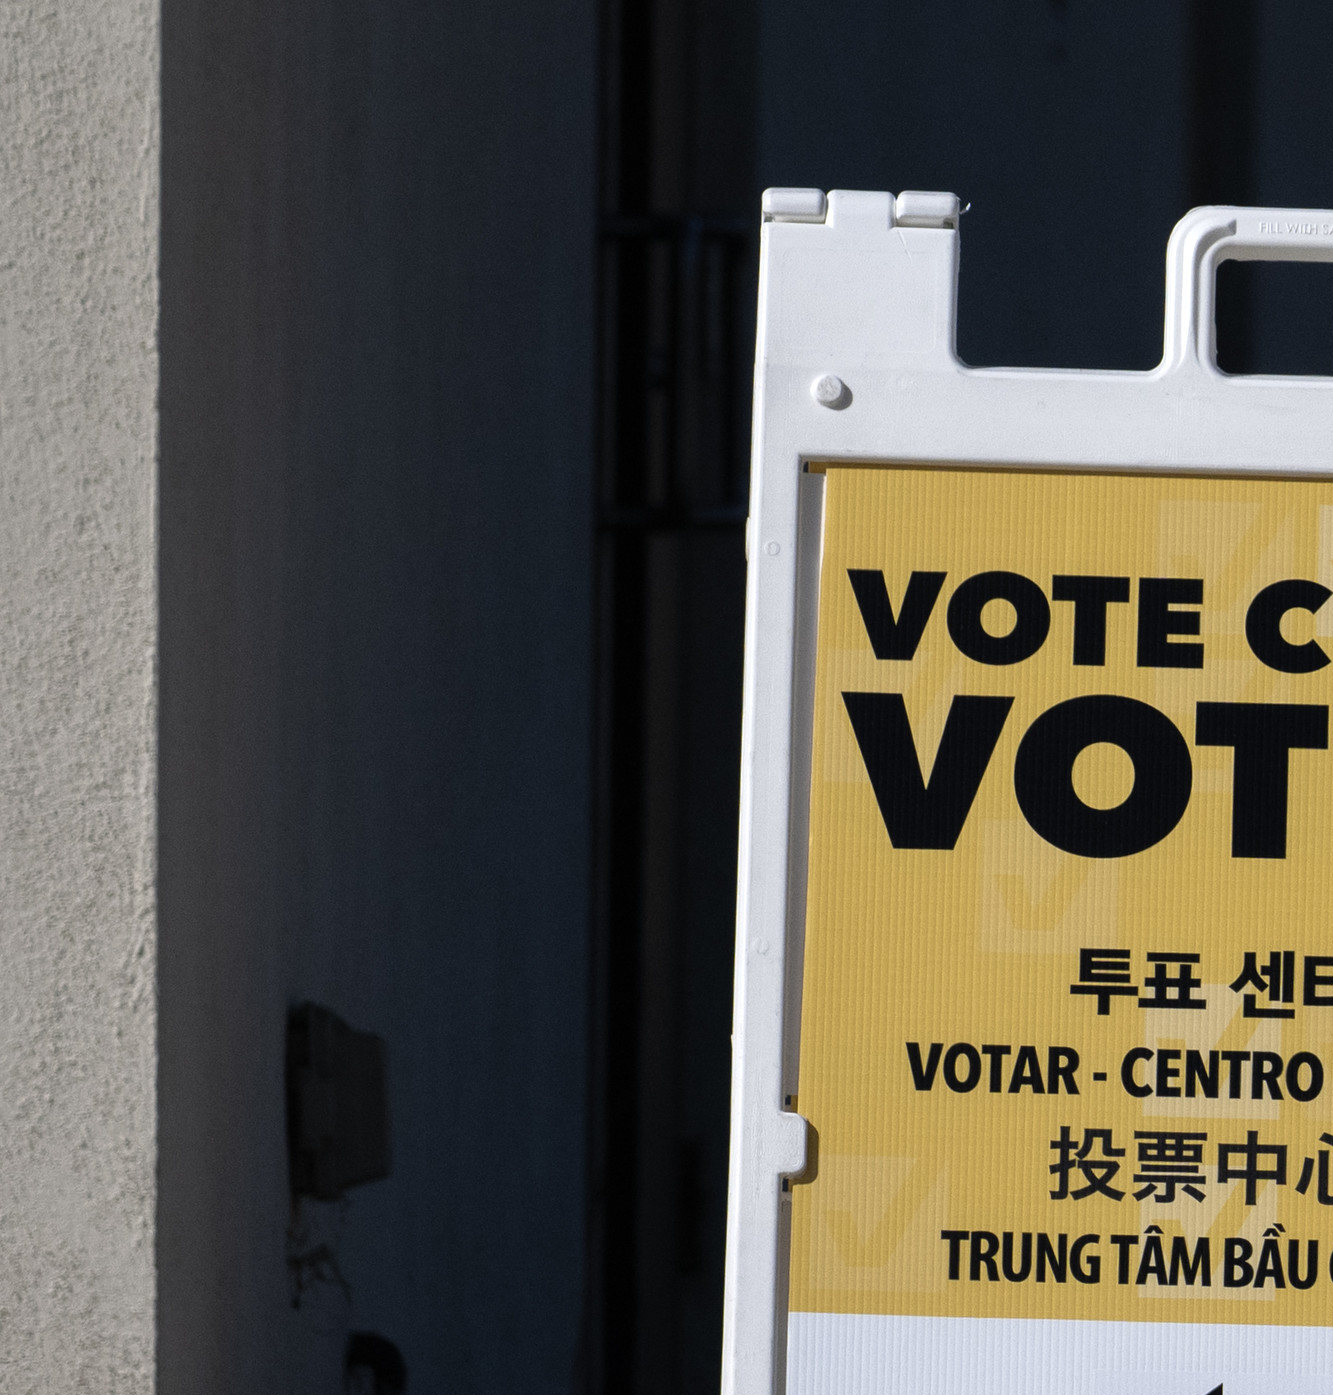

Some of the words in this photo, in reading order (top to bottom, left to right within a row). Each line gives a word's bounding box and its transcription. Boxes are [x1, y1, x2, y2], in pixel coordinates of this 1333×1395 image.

[1259, 221, 1282, 234] FILL
[1286, 223, 1318, 235] WITH
[847, 569, 1204, 668] VOTE
[1070, 949, 1206, 1015] 투표
[906, 1043, 1079, 1094] VOTAR
[1121, 1048, 1323, 1101] CENTRO
[941, 1230, 1100, 1284] TRUNG
[1111, 1226, 1211, 1286] TÂM
[1224, 1224, 1318, 1289] BẦU
